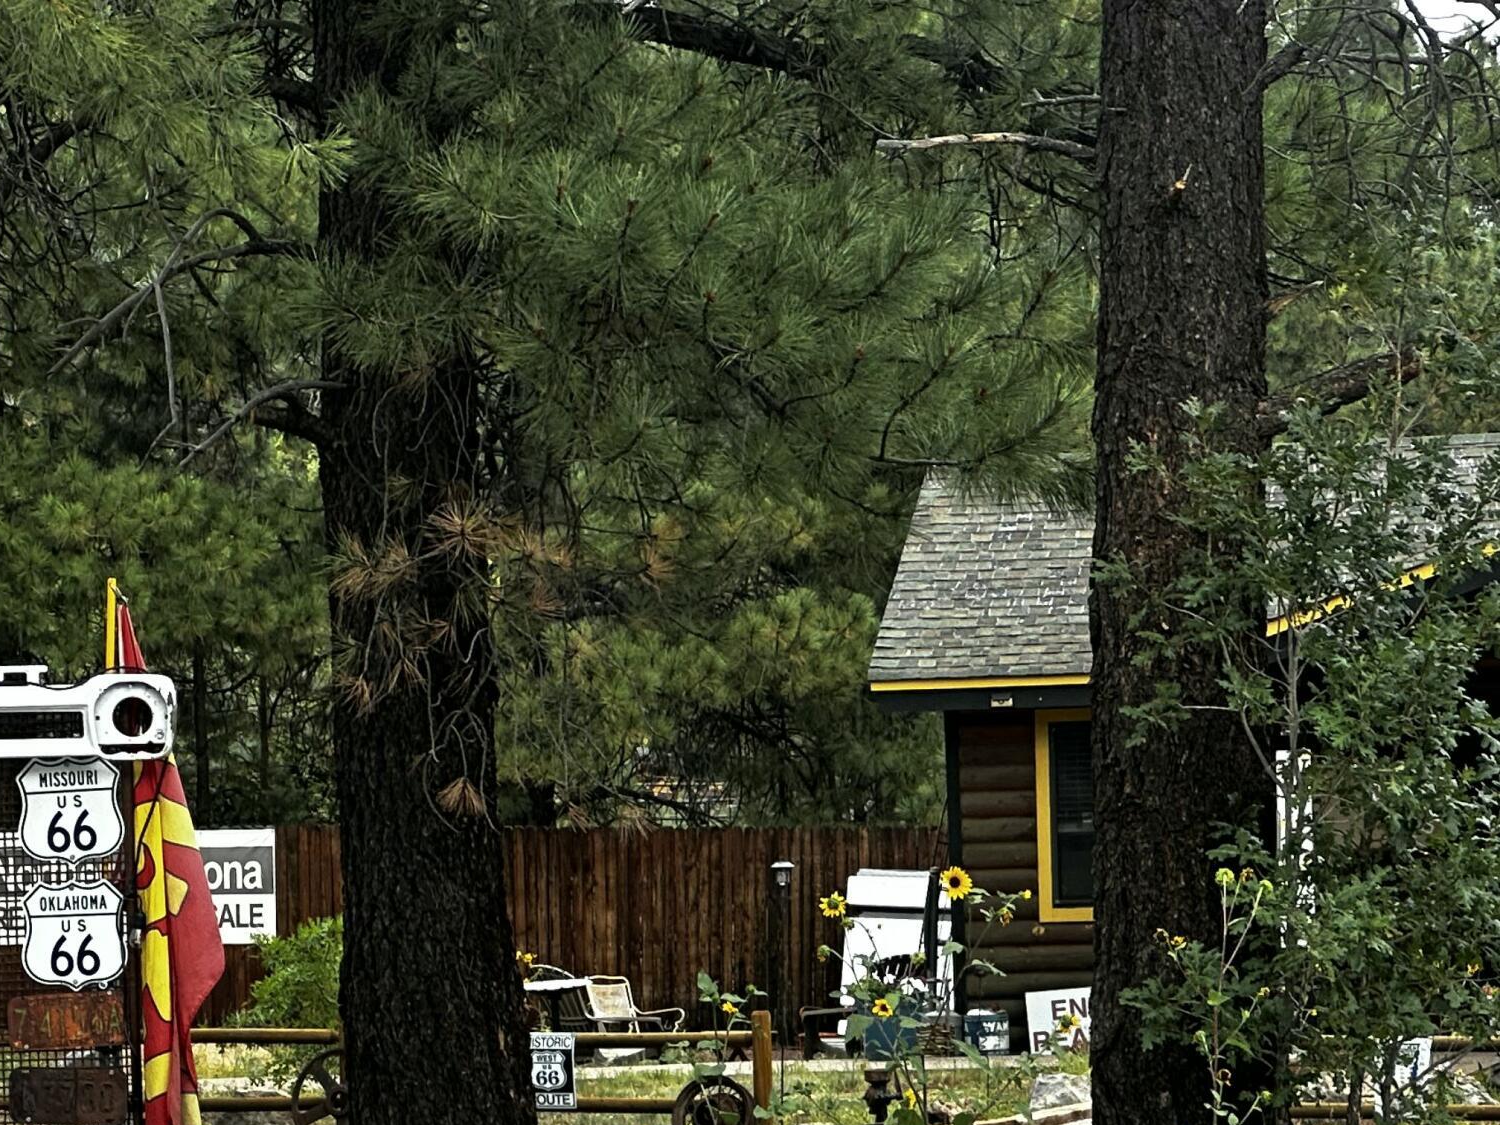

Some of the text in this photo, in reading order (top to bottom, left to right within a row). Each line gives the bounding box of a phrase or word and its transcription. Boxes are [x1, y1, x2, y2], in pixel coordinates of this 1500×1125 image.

[39, 769, 98, 788] MISSOURI
[47, 809, 98, 853] 66
[39, 894, 108, 912] OKLAHOMA
[213, 903, 264, 928] ALE
[50, 933, 101, 978] 66
[536, 1070, 560, 1086] 66
